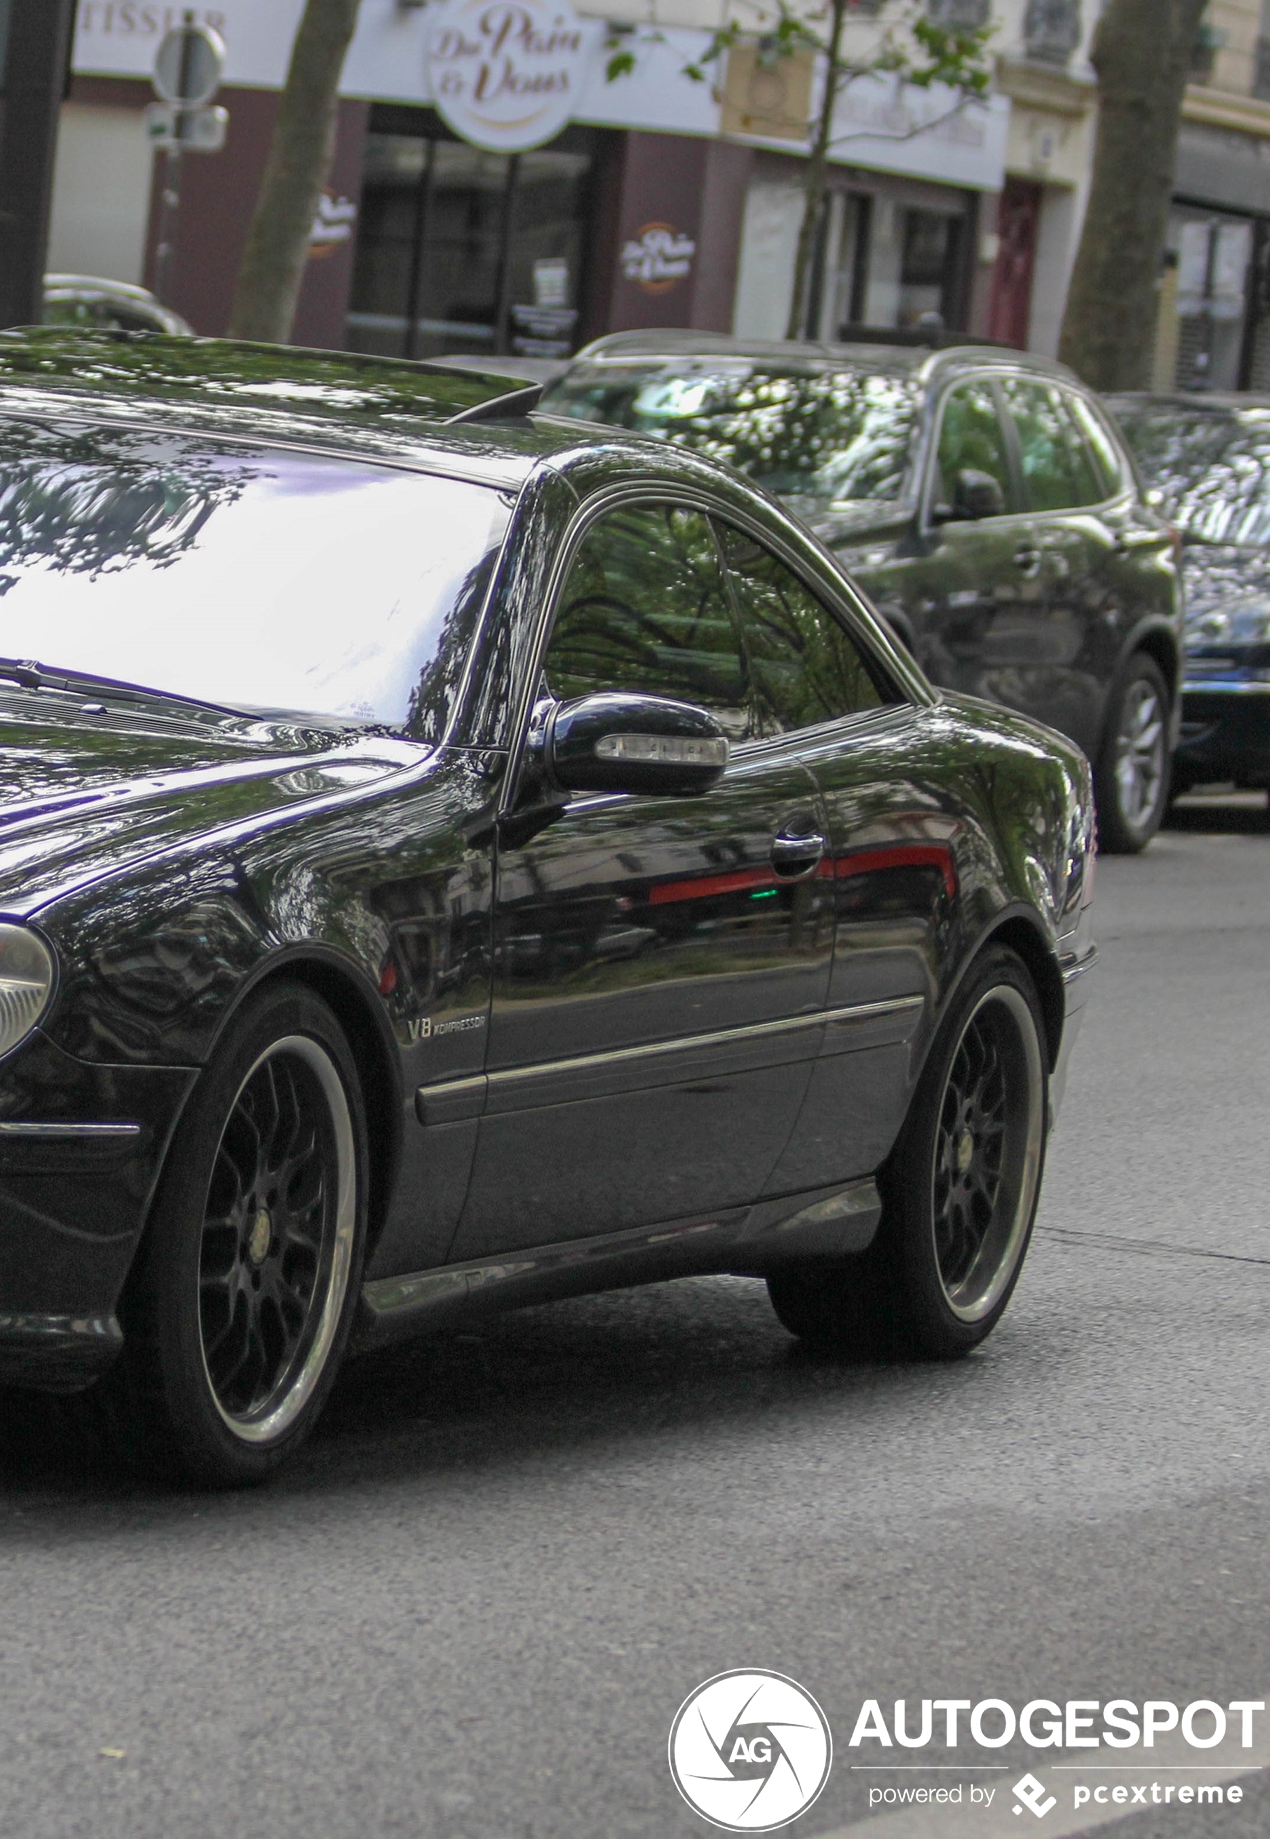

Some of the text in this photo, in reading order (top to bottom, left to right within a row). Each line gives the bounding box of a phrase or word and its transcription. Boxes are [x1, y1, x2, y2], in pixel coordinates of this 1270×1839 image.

[430, 3, 581, 60] Du Pain
[474, 54, 570, 102] Vous
[408, 1016, 486, 1040] V8 KOMPRESSOR
